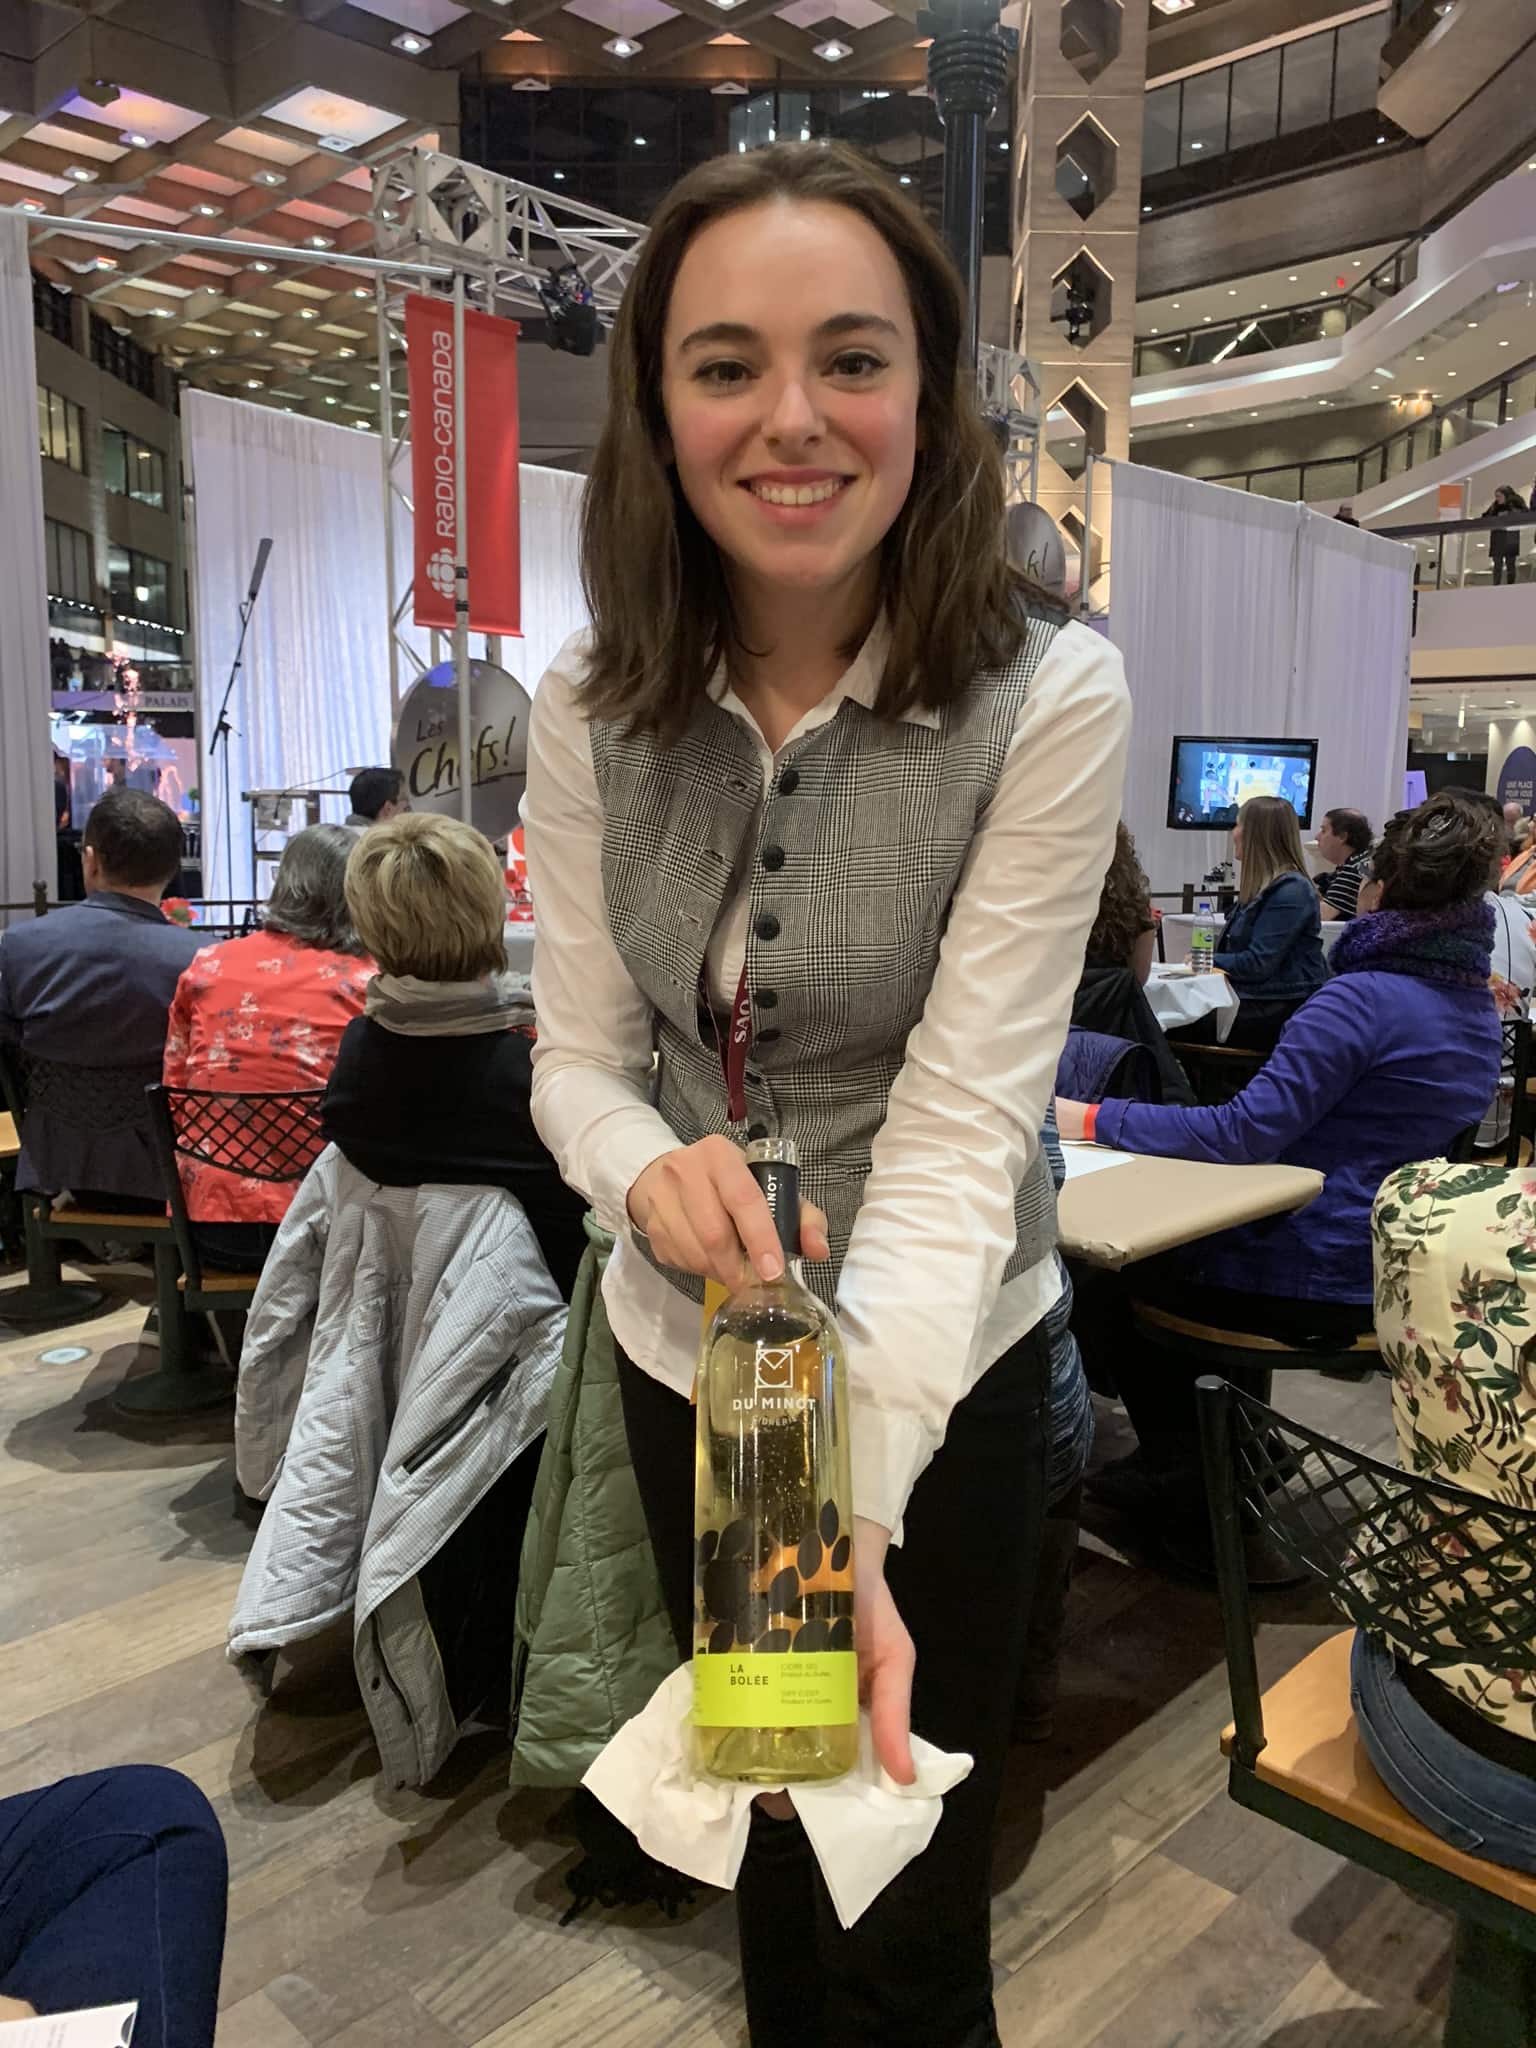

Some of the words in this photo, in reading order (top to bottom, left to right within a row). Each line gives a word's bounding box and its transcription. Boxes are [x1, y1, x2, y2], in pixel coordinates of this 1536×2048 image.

[416, 719, 444, 742] Les
[409, 716, 517, 798] Chfs!
[733, 1398, 753, 1411] DU
[762, 1397, 816, 1411] MINOT
[730, 1663, 745, 1674] LA
